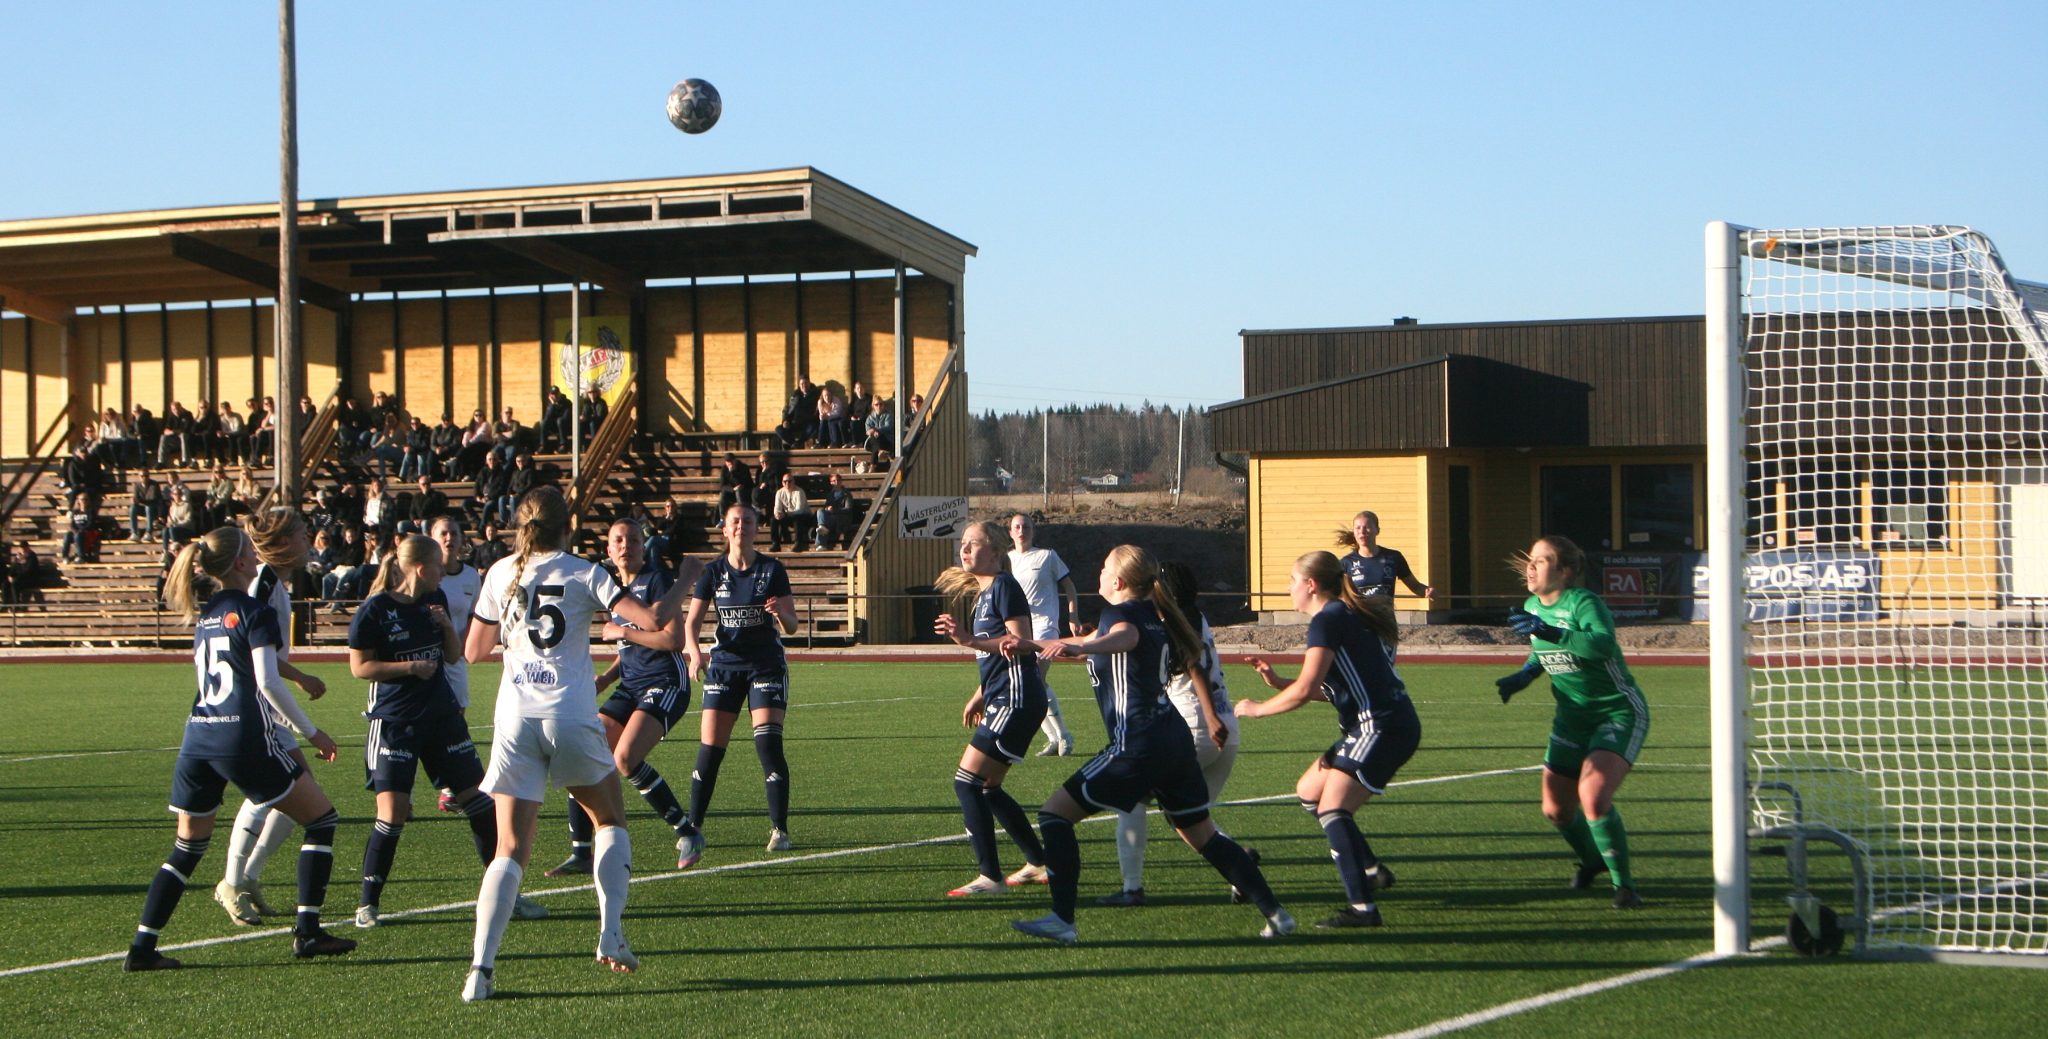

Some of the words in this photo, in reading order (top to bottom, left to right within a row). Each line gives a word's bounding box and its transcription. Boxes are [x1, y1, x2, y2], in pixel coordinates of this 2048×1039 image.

[933, 509, 959, 524] FASAD
[1609, 573, 1638, 592] RA
[1820, 565, 1867, 588] AB
[193, 635, 234, 708] 15
